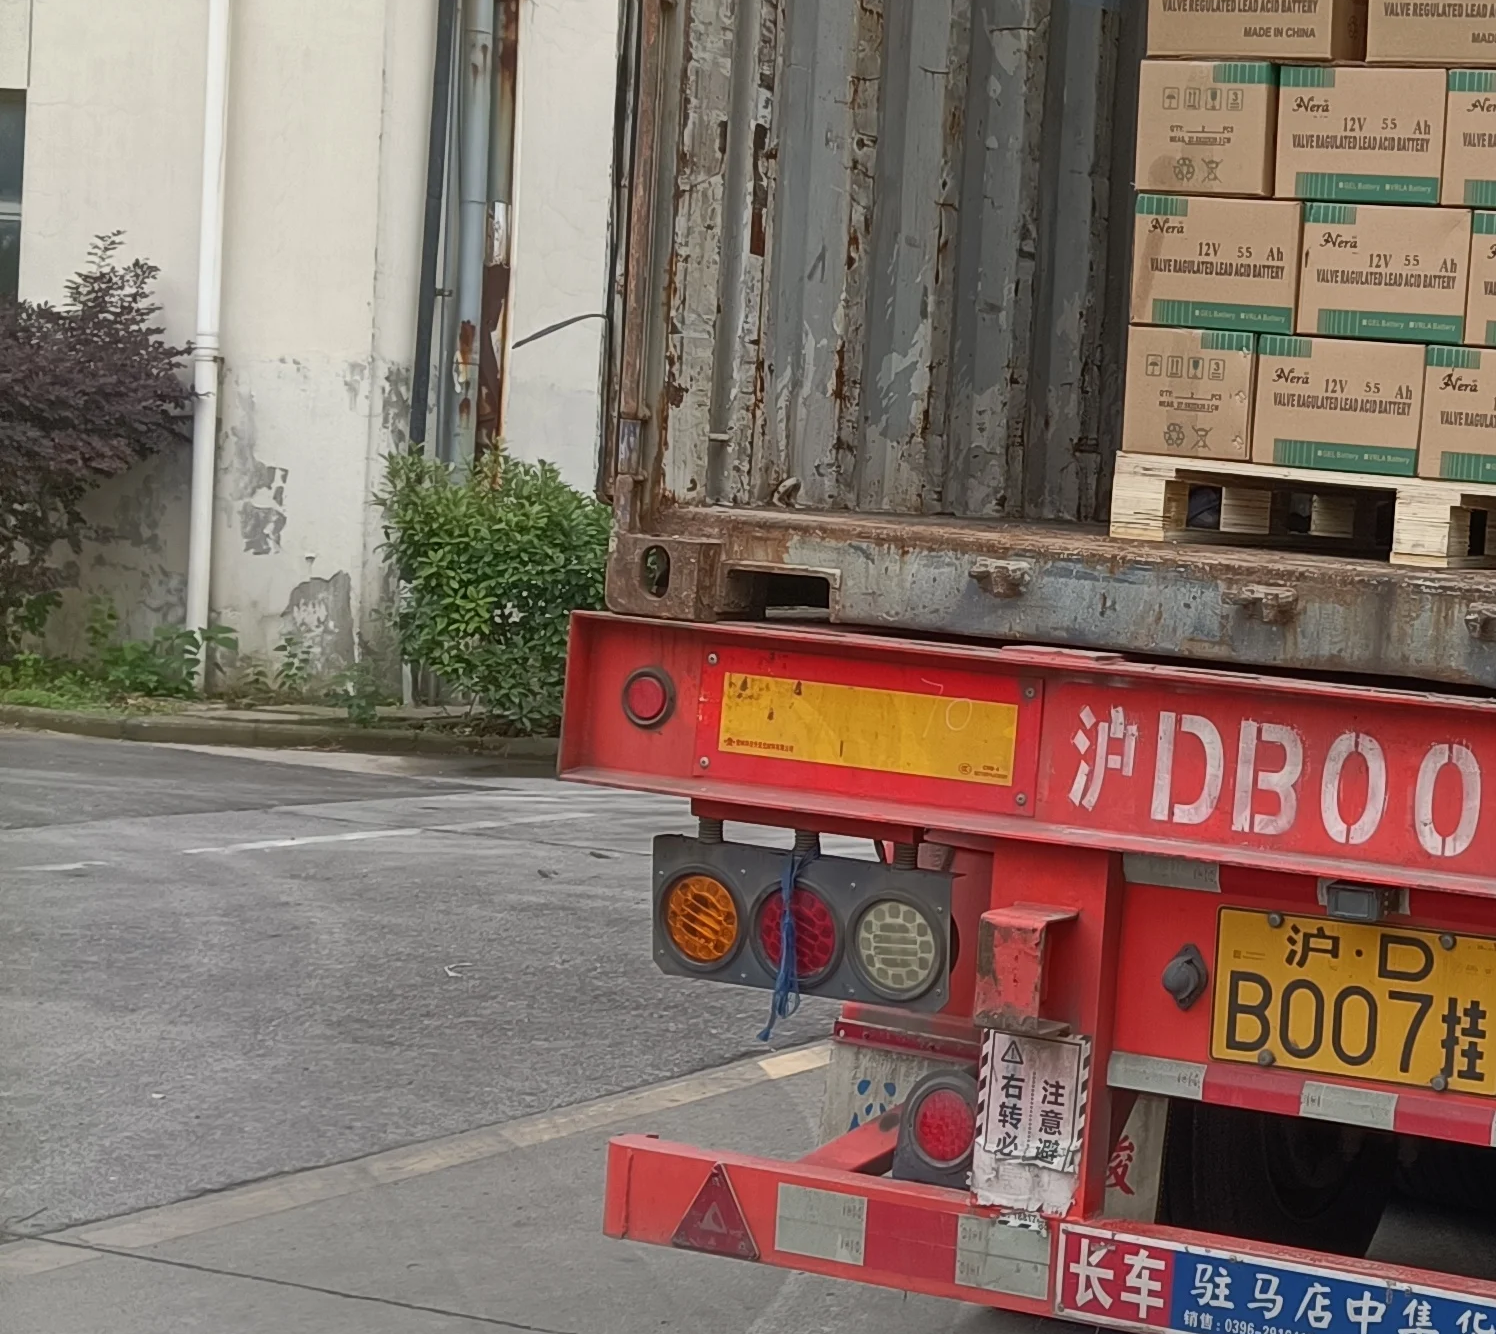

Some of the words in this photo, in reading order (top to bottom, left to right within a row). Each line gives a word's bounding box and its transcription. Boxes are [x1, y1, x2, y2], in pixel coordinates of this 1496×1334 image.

[1238, 0, 1258, 13] LEAD
[1260, 0, 1279, 13] ACID
[1281, 0, 1318, 13] BATTERY
[1384, 2, 1411, 17] VALVE
[1412, 2, 1463, 18] REGULATED
[1465, 3, 1487, 18] LEAD
[1244, 27, 1271, 37] MADE
[1274, 27, 1283, 37] IN
[1286, 27, 1315, 38] CHINA
[1343, 117, 1367, 132] 12V
[1381, 118, 1397, 129] 55
[1413, 120, 1431, 135] Ah
[1292, 134, 1314, 149] VALVE
[1315, 135, 1357, 150] RAGULATED
[1358, 136, 1377, 151] LEAD
[1378, 137, 1395, 151] ACID
[1397, 137, 1430, 152] BATTERY
[1463, 132, 1486, 148] VALVE
[1198, 242, 1221, 257] 12V
[1237, 246, 1252, 258] 55
[1266, 247, 1283, 261] Ah
[1151, 258, 1172, 274] VALVE
[1173, 259, 1214, 276] RAGULATED
[1215, 261, 1232, 277] LEAD
[1234, 262, 1251, 278] ACID
[1253, 263, 1285, 280] BATTERY
[1369, 254, 1392, 268] 12V
[1404, 255, 1419, 266] 55
[1439, 258, 1457, 273] Ah
[1317, 269, 1339, 284] VALVE
[1341, 270, 1382, 286] RAGULATED
[1384, 272, 1402, 287] LEAD
[1404, 273, 1421, 288] ACID
[1423, 274, 1456, 289] BATTERY
[1325, 379, 1348, 393] 12V
[1364, 382, 1380, 394] 55
[1395, 385, 1412, 400] Ah
[1274, 392, 1296, 409] VALVE
[1297, 394, 1338, 411] RAGULATED
[1340, 396, 1358, 413] LEAD
[1359, 397, 1377, 414] ACID
[1378, 399, 1411, 416] BATTERY
[1440, 411, 1463, 427] VALVE
[1225, 969, 1488, 1082] B007挂
[1069, 1238, 1166, 1319] 长车
